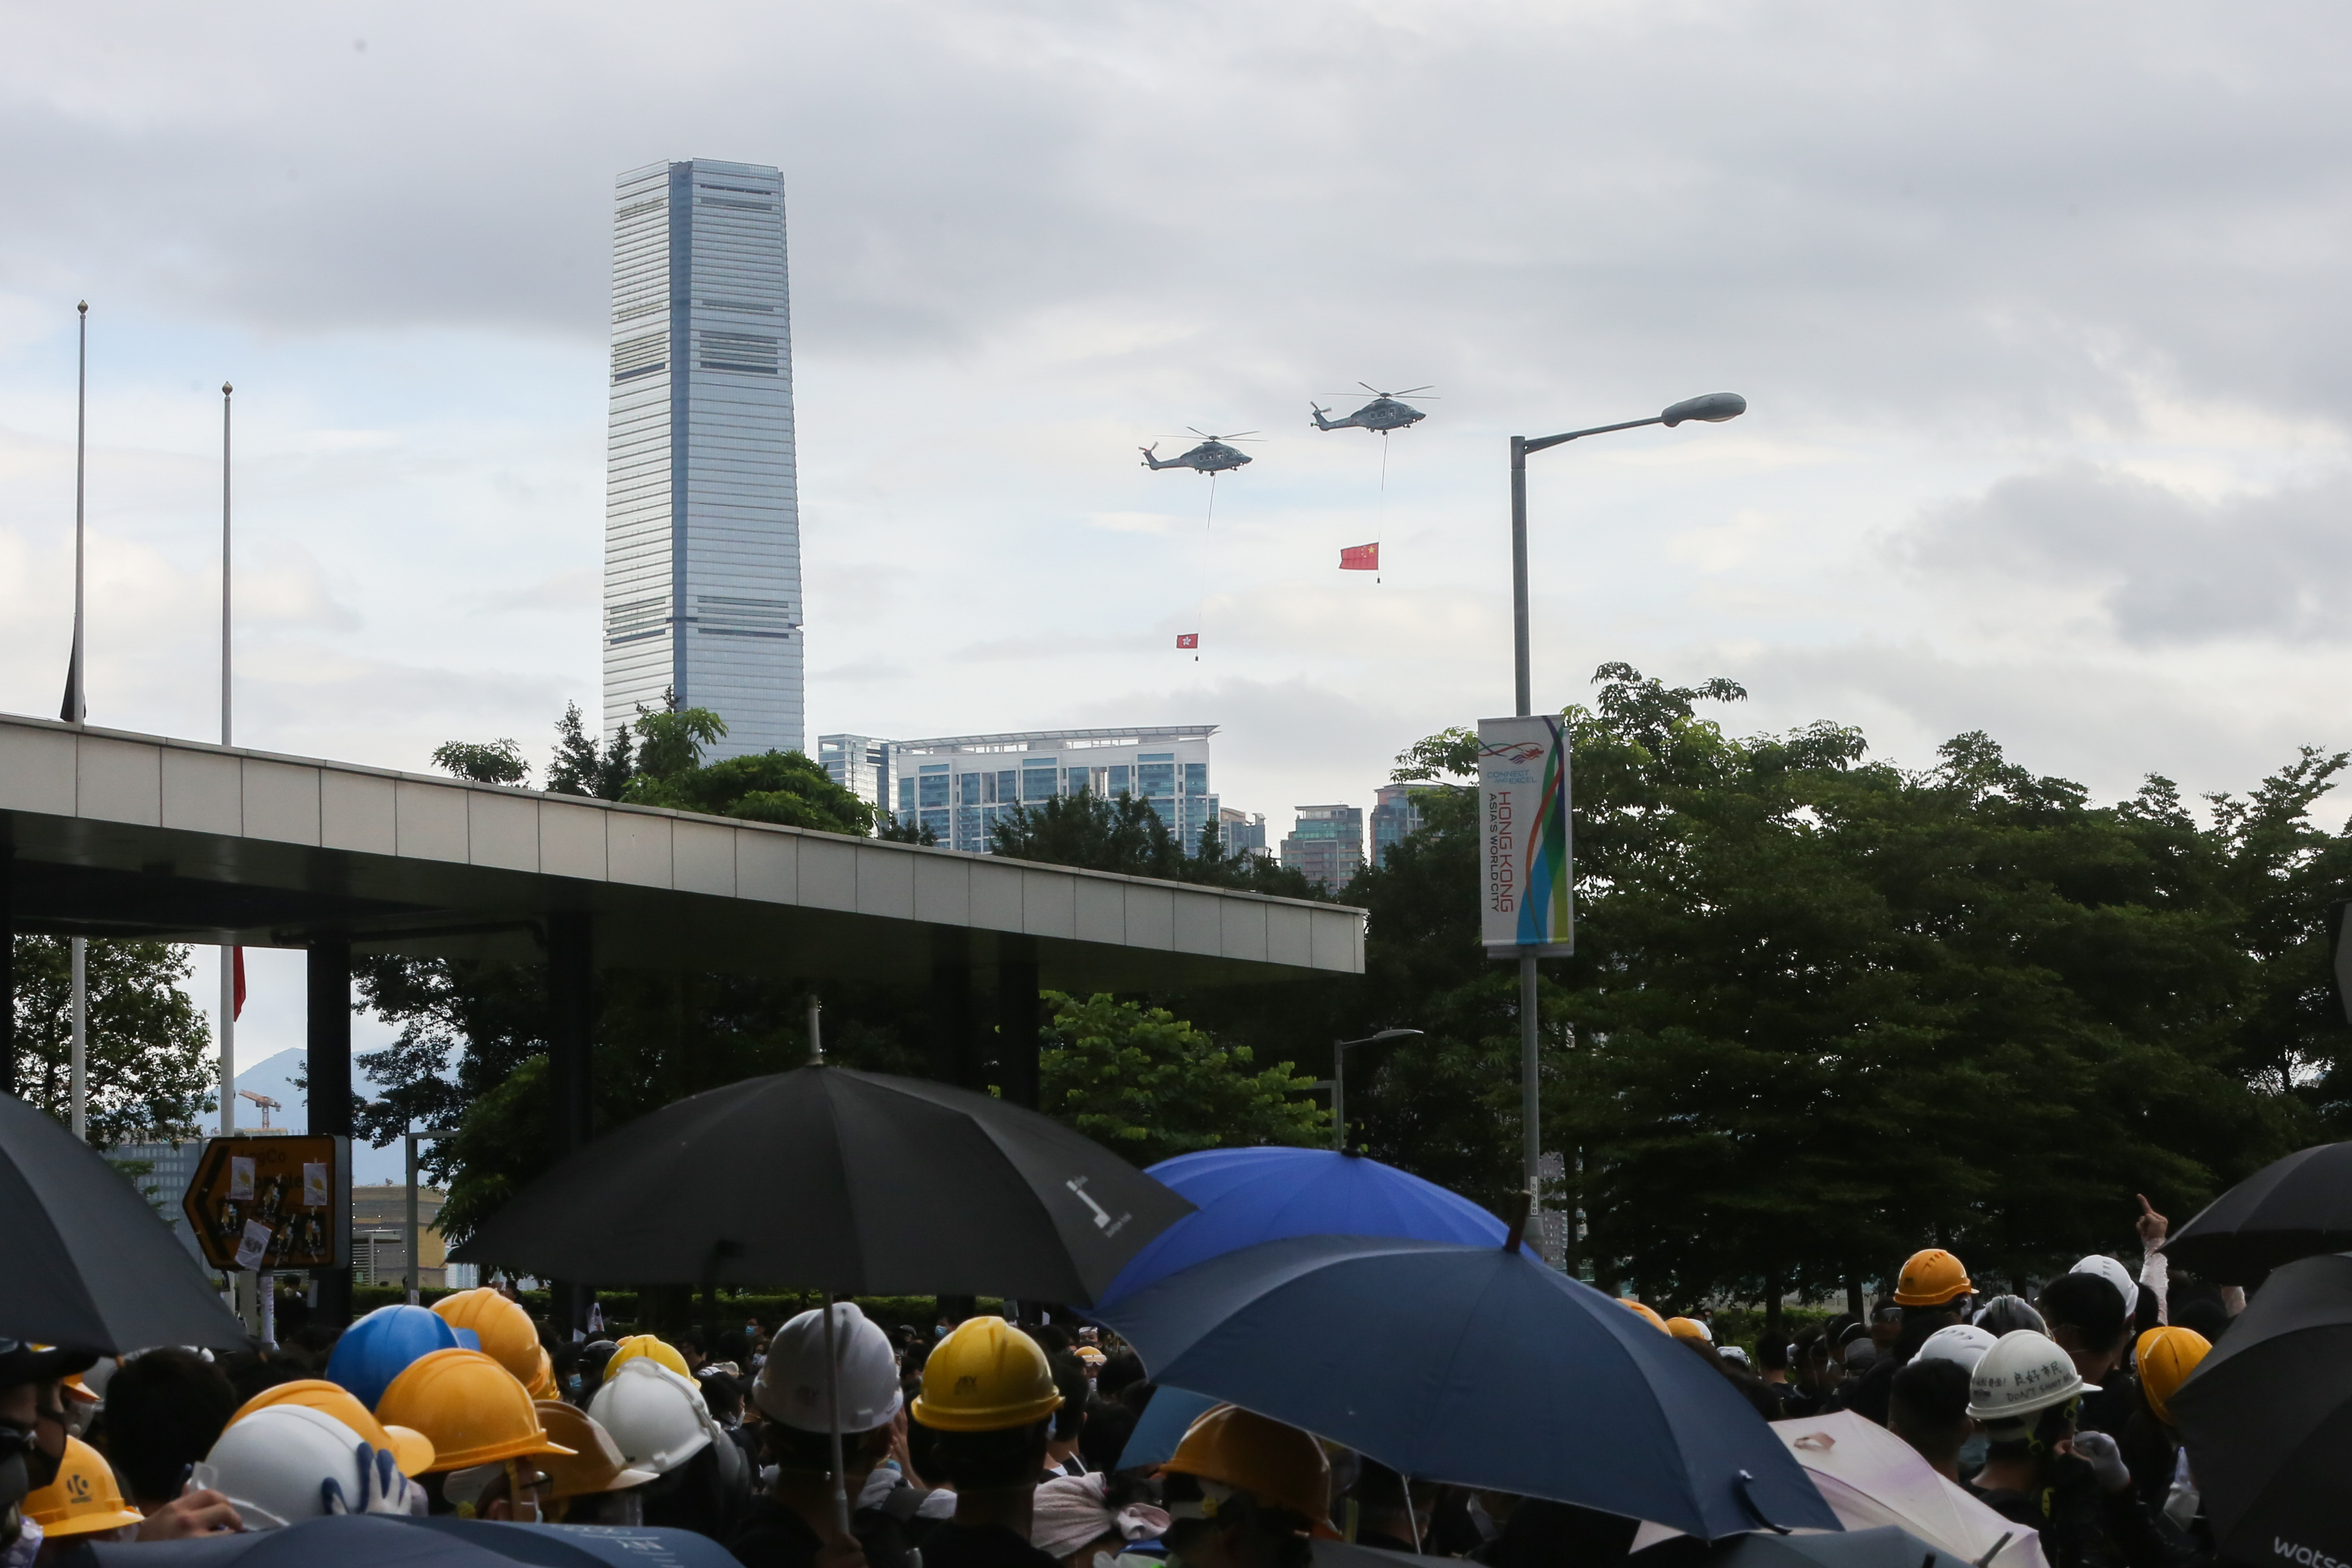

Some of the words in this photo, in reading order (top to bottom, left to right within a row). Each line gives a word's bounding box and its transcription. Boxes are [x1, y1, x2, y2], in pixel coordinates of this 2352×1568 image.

[1487, 770, 1530, 778] CONNECT
[1489, 793, 1497, 832] ASIA'S
[1499, 791, 1512, 850] HONG
[1491, 882, 1499, 912] CITY
[1500, 853, 1513, 912] KONG
[2013, 1361, 2062, 1386] 良好市民
